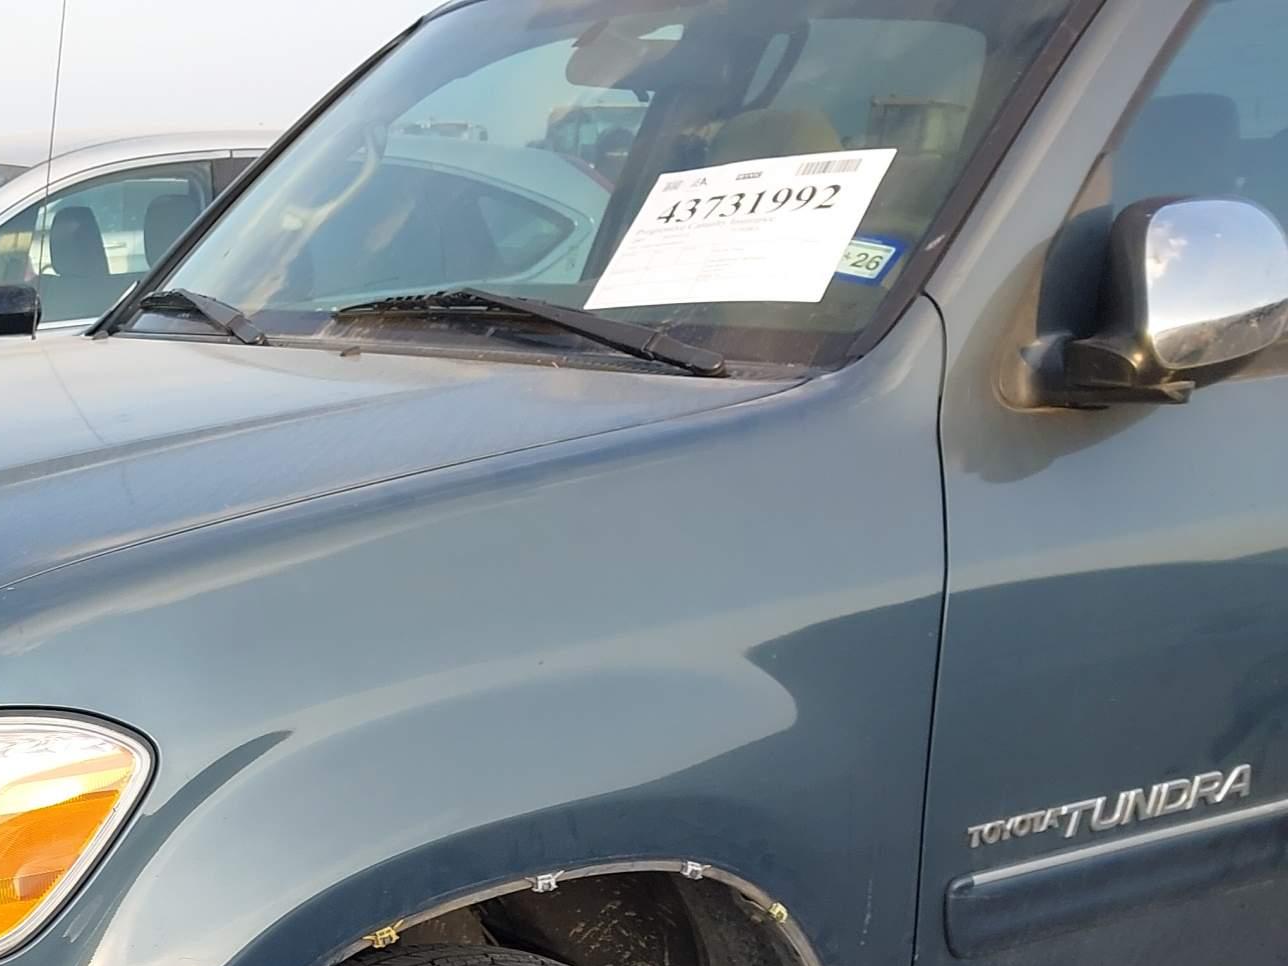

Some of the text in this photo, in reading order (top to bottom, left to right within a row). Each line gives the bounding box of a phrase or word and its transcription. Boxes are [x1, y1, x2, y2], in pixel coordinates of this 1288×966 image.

[657, 184, 842, 224] 43731992
[850, 252, 884, 271] 26
[968, 763, 1252, 849] TOYOTA TUNDRA
